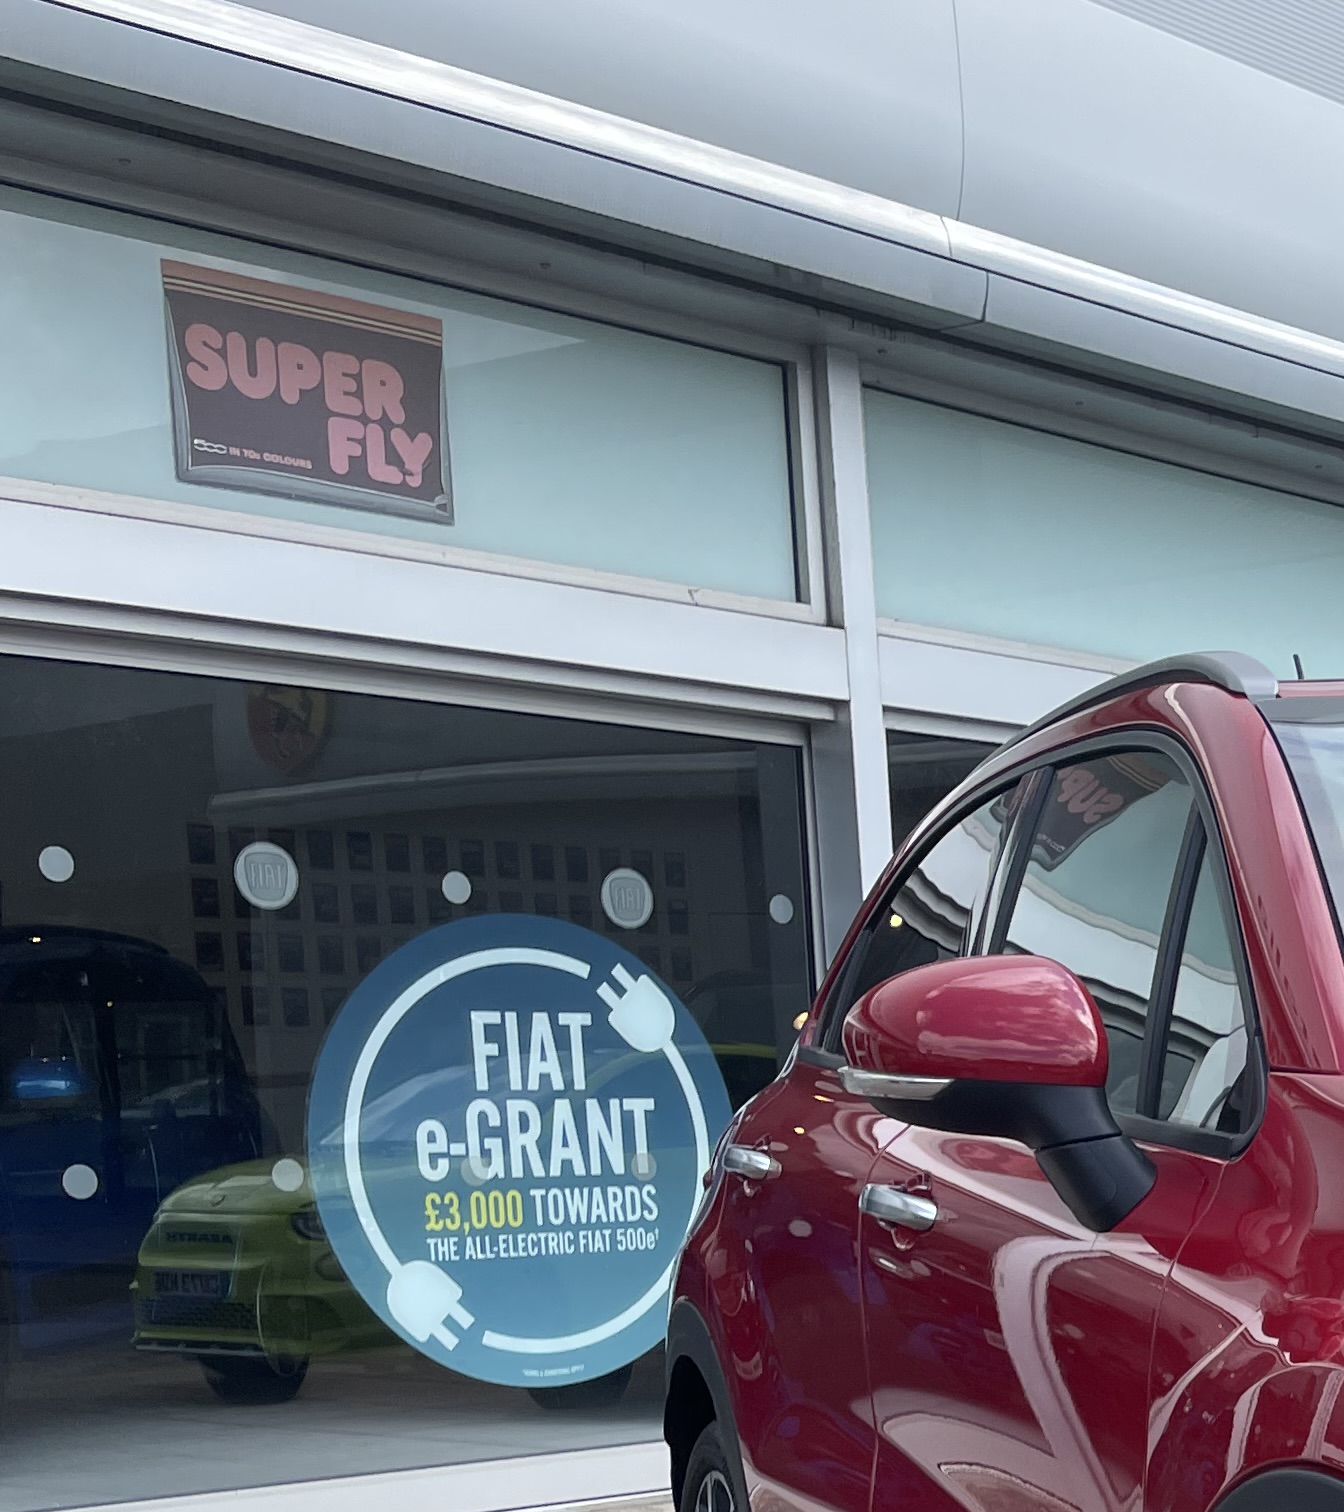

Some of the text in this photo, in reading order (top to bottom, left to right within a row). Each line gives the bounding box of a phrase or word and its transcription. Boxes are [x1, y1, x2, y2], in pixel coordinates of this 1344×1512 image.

[184, 323, 406, 424] SUPER
[326, 416, 433, 488] FLY
[469, 1010, 592, 1092] FIAT
[415, 1097, 655, 1182] e-GRANT
[424, 1184, 659, 1237] £3,000 TOWARDS
[426, 1237, 460, 1262] THE
[464, 1230, 576, 1261] ALL-ELECTRIC
[579, 1228, 612, 1253] FIAT
